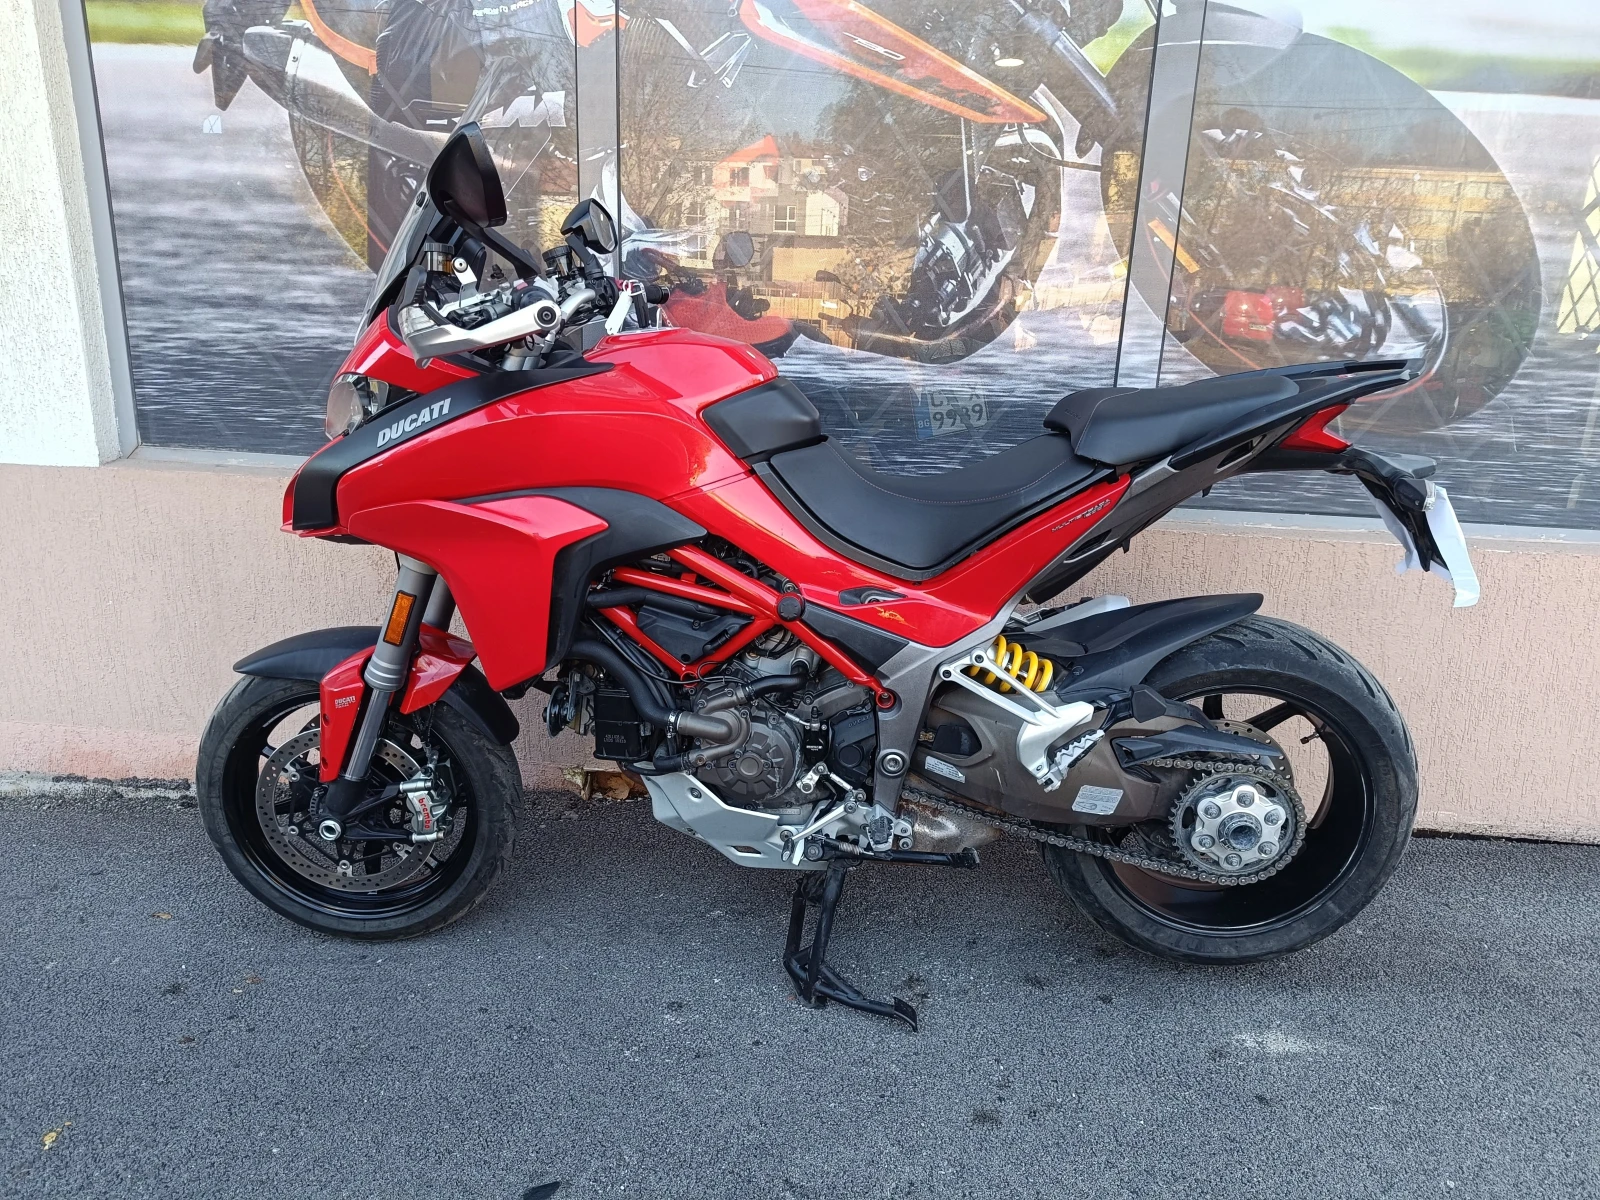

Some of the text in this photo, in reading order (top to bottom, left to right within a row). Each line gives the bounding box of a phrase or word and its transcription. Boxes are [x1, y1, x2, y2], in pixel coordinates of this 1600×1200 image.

[376, 397, 452, 448] DUCATI
[334, 695, 356, 705] DUCATI
[418, 797, 432, 829] brembo
